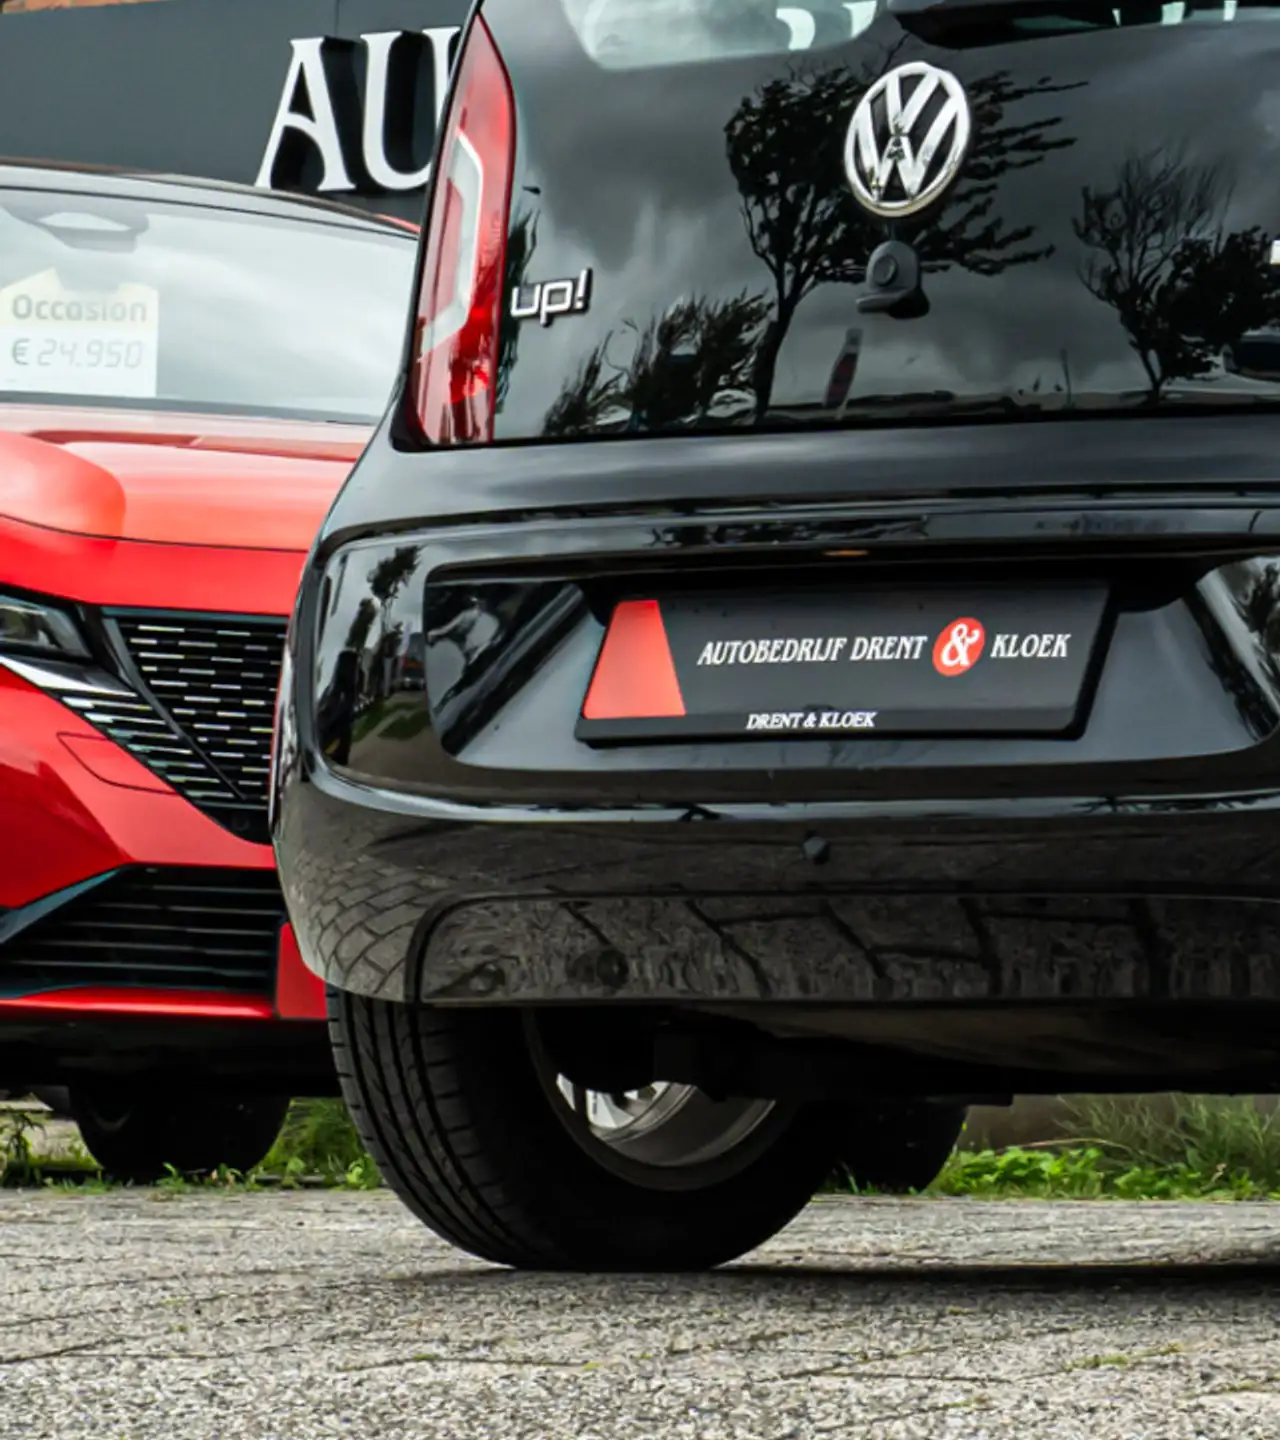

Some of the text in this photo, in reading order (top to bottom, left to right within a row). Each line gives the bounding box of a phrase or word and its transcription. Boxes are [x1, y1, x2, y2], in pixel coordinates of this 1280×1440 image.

[12, 293, 147, 323] Occasion
[510, 268, 591, 327] up!
[12, 337, 144, 369] € 24.950
[697, 623, 1071, 667] AUTOBEDRIJF DRENT & KLOEK
[746, 711, 878, 730] DRENT & KLOEK
